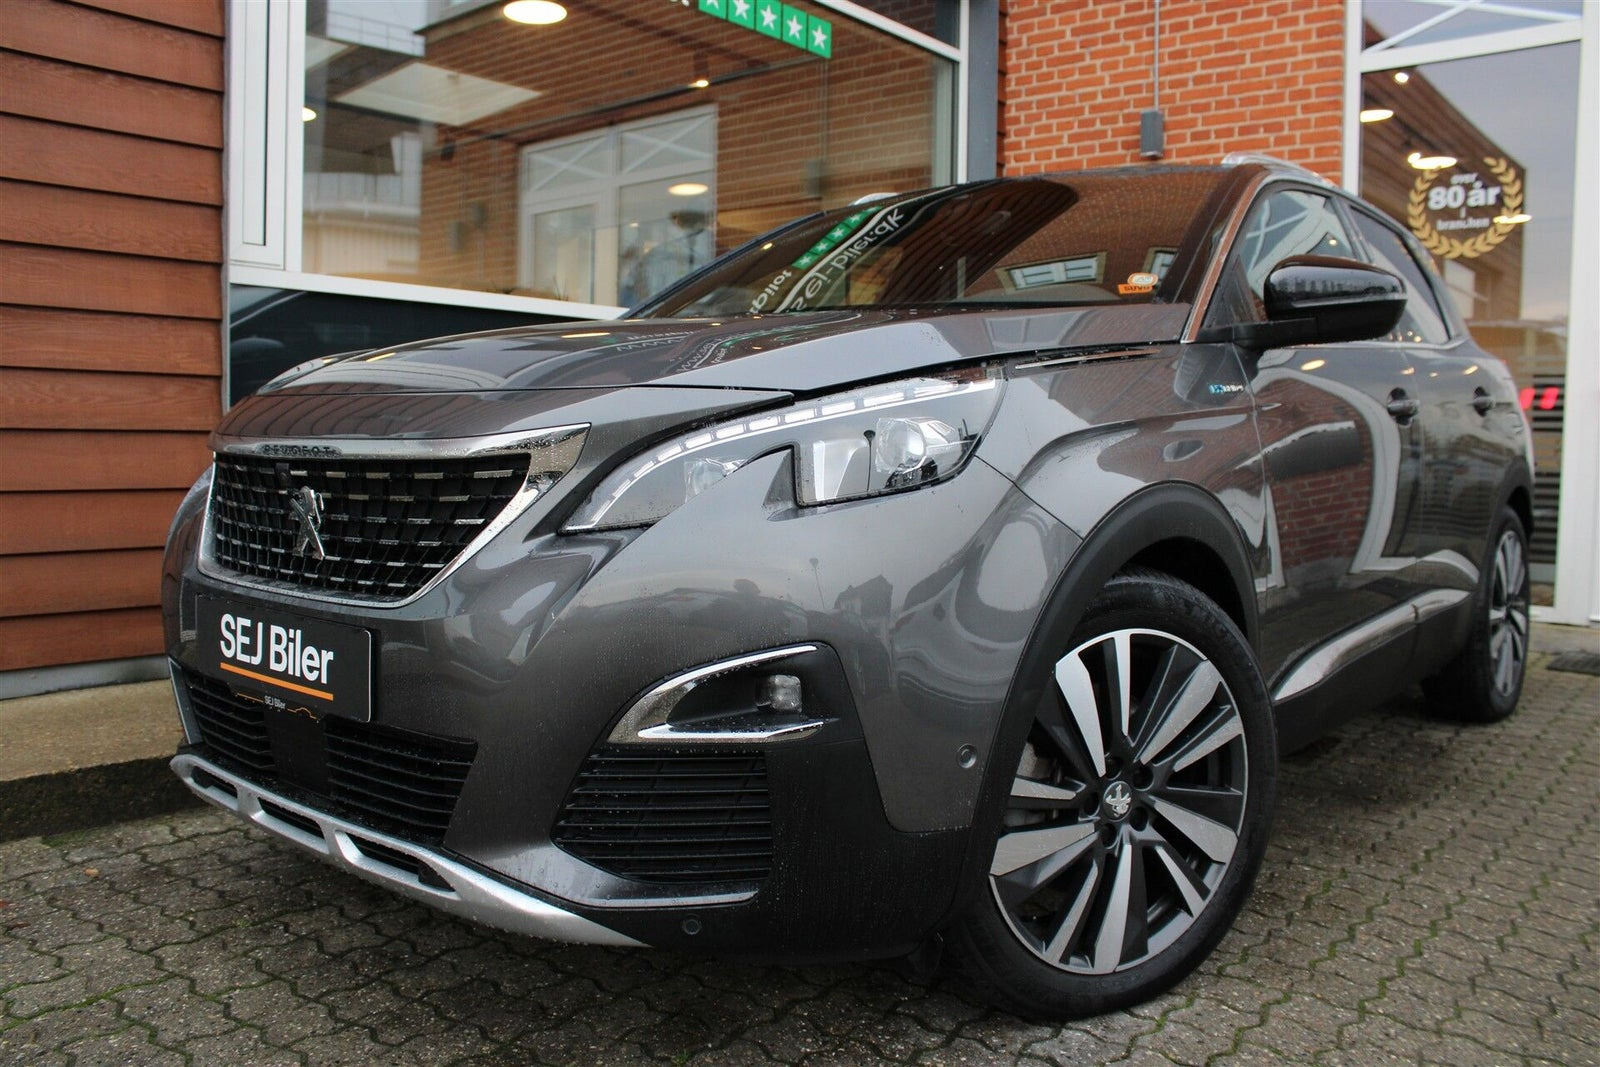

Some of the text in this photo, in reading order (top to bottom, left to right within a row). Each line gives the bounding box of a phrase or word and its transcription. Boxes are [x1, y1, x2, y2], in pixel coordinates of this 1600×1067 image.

[1428, 180, 1501, 210] 80 år
[263, 443, 331, 457] PEUGEOT
[220, 613, 334, 685] SEJ Biler
